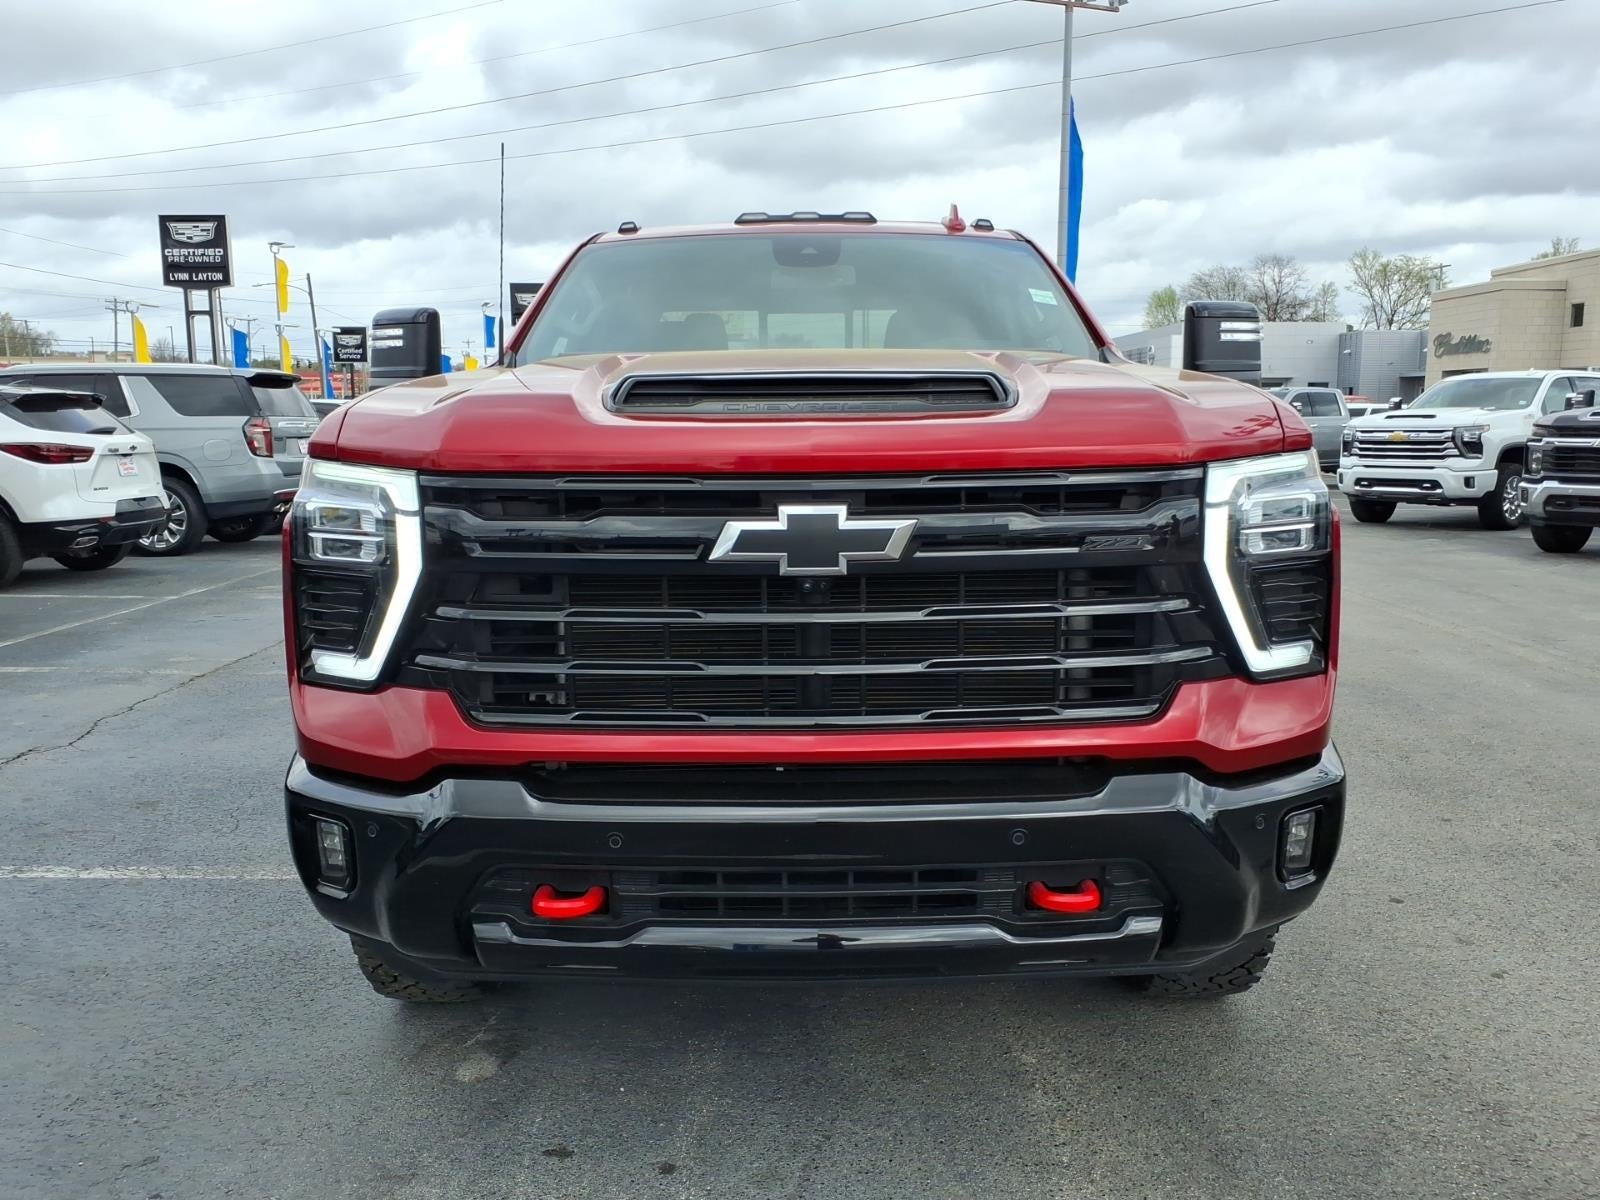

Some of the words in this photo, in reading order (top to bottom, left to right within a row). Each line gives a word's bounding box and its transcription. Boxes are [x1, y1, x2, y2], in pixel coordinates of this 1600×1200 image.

[164, 248, 224, 256] CERTIFIED
[167, 255, 221, 263] PRE-OWNED
[169, 272, 189, 281] LYNN
[192, 272, 223, 281] LAYTON
[722, 402, 898, 413] CHEVROLET
